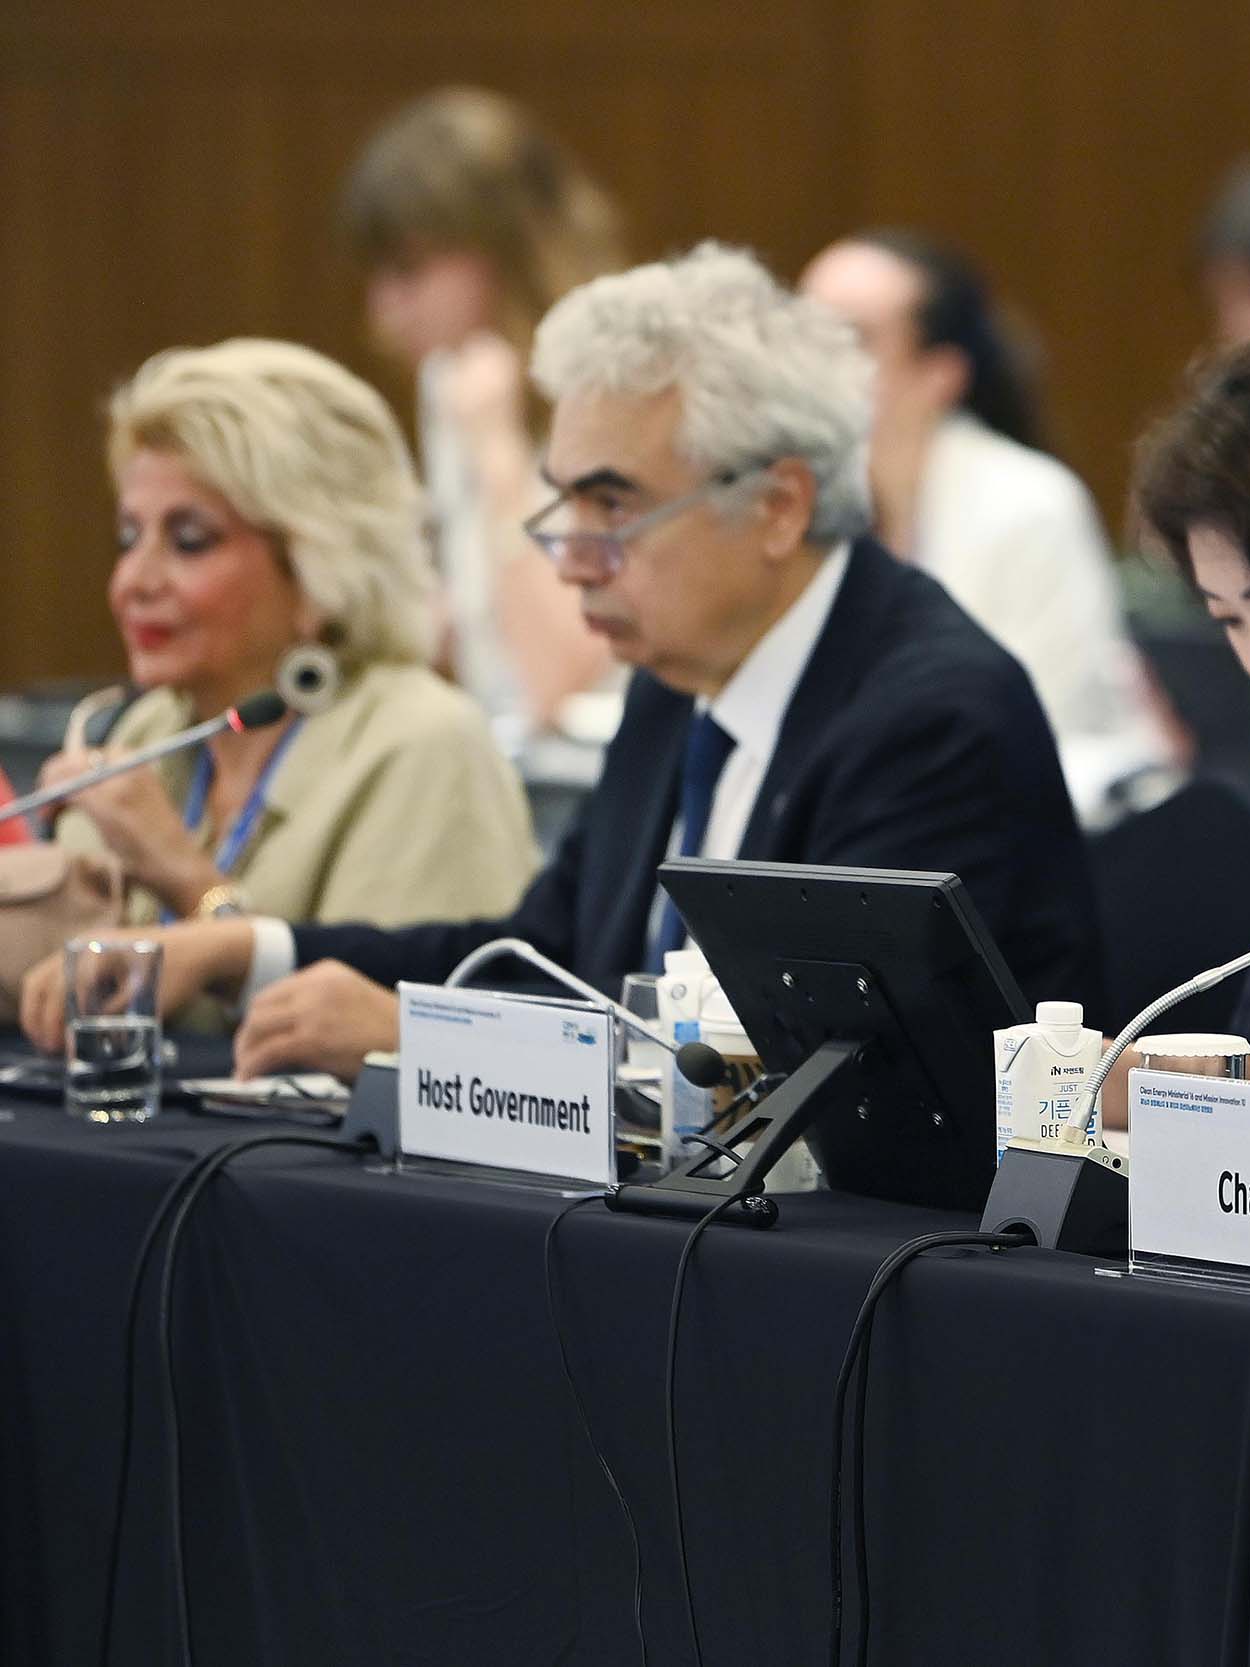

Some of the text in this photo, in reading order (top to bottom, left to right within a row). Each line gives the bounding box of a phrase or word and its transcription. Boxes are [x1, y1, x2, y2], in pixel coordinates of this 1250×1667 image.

[1059, 1084, 1078, 1093] JUST
[418, 1069, 590, 1134] Host Government
[1041, 1124, 1063, 1138] DEE
